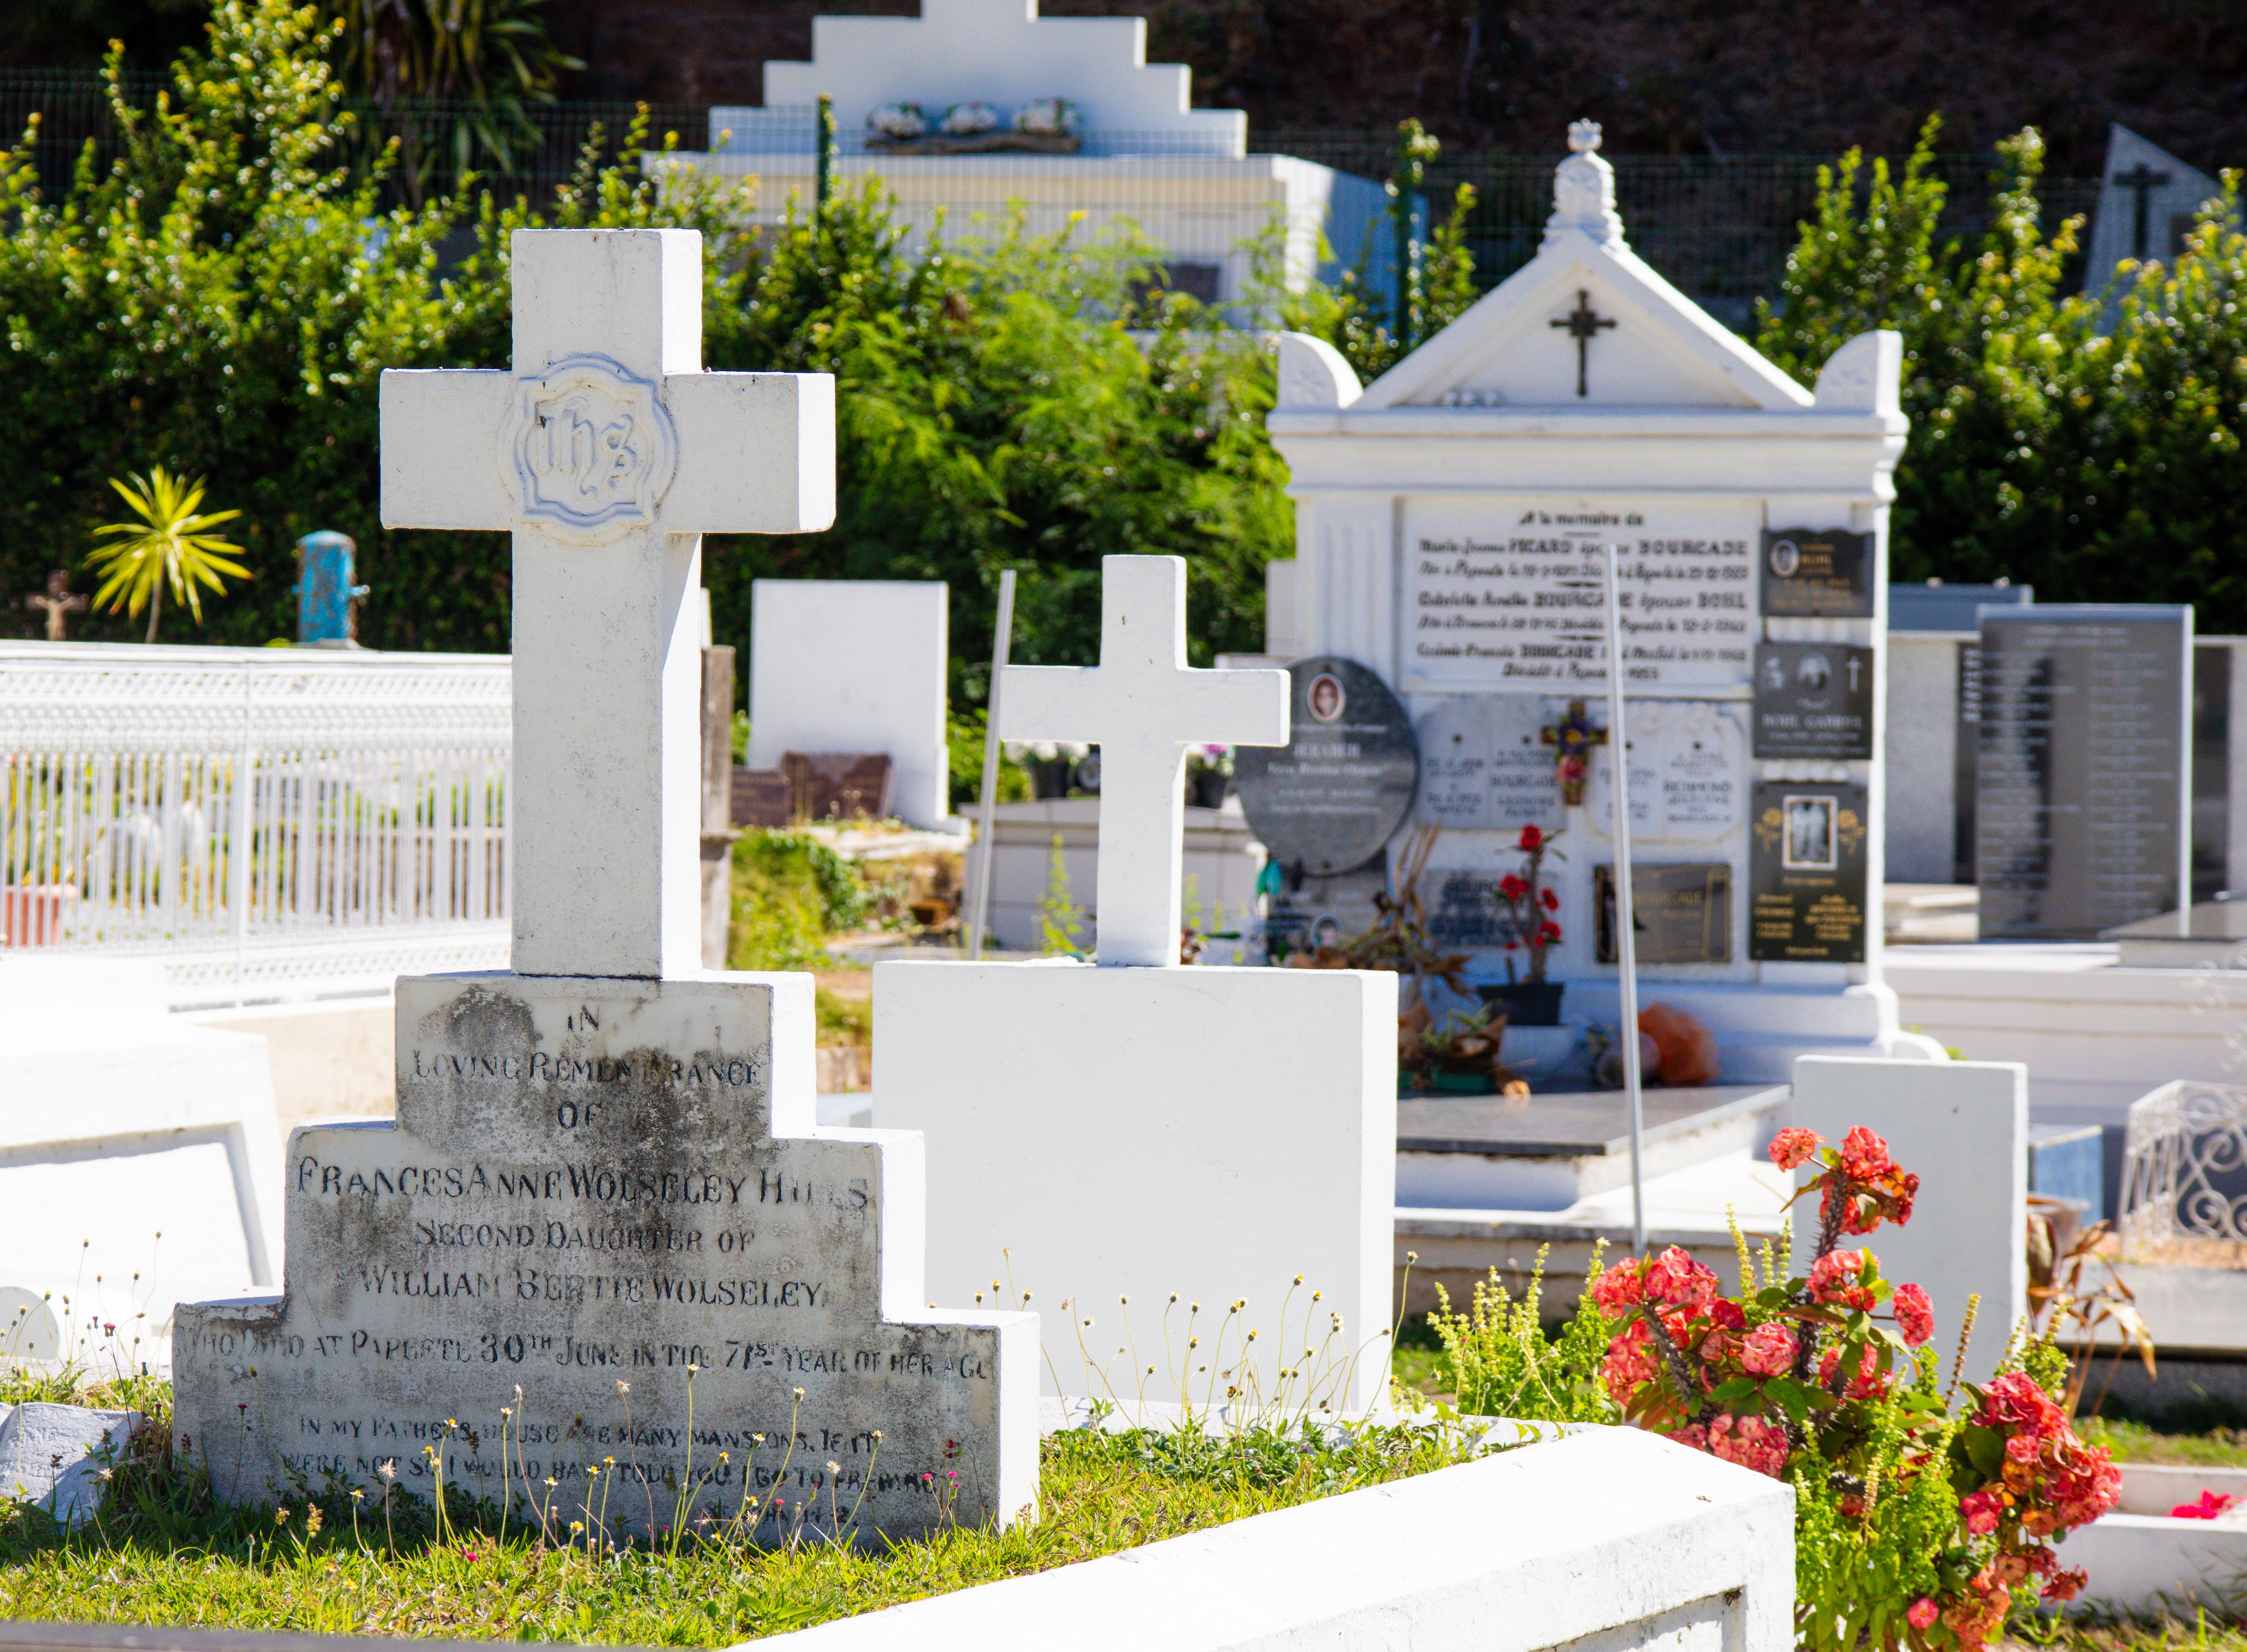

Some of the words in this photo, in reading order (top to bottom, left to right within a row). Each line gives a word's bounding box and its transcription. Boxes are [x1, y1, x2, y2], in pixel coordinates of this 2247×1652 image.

[567, 1004, 600, 1032] IN
[413, 1049, 521, 1080] LOVING
[558, 1101, 603, 1130] OF
[298, 1156, 463, 1198] FRANCES
[415, 1219, 534, 1247] SECOND
[546, 1221, 702, 1252] DAUGHTER
[718, 1228, 755, 1253] OF
[358, 1264, 500, 1298] WILLIAM
[314, 1335, 342, 1357] AT
[556, 1335, 621, 1367] JUNE
[634, 1342, 655, 1367] IN
[890, 1351, 933, 1377] HER
[331, 1419, 362, 1438] MY
[618, 1426, 681, 1448] MANY
